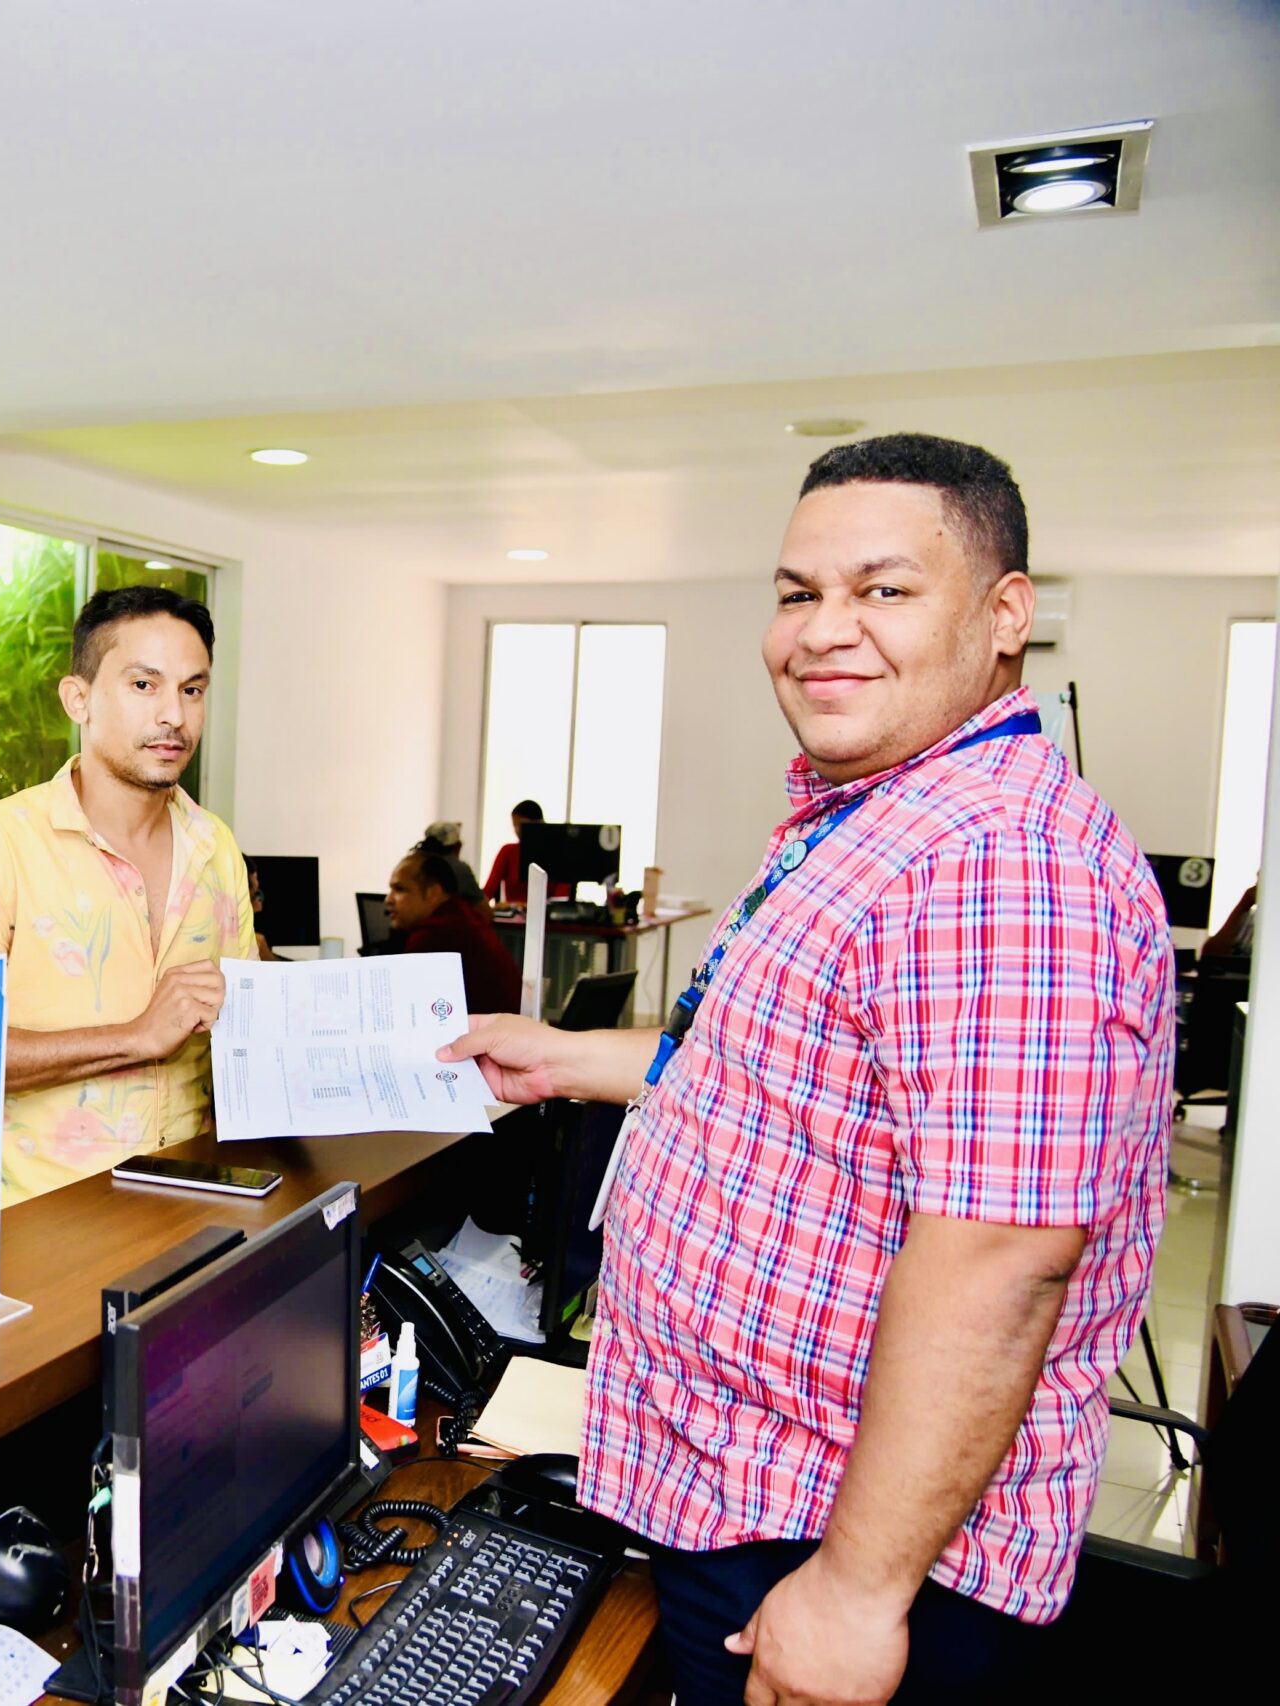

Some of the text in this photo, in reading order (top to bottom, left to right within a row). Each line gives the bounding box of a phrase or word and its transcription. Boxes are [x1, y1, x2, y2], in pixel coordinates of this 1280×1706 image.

[1186, 860, 1203, 883] 3
[380, 1368, 389, 1380] 01
[459, 1529, 478, 1549] acer
